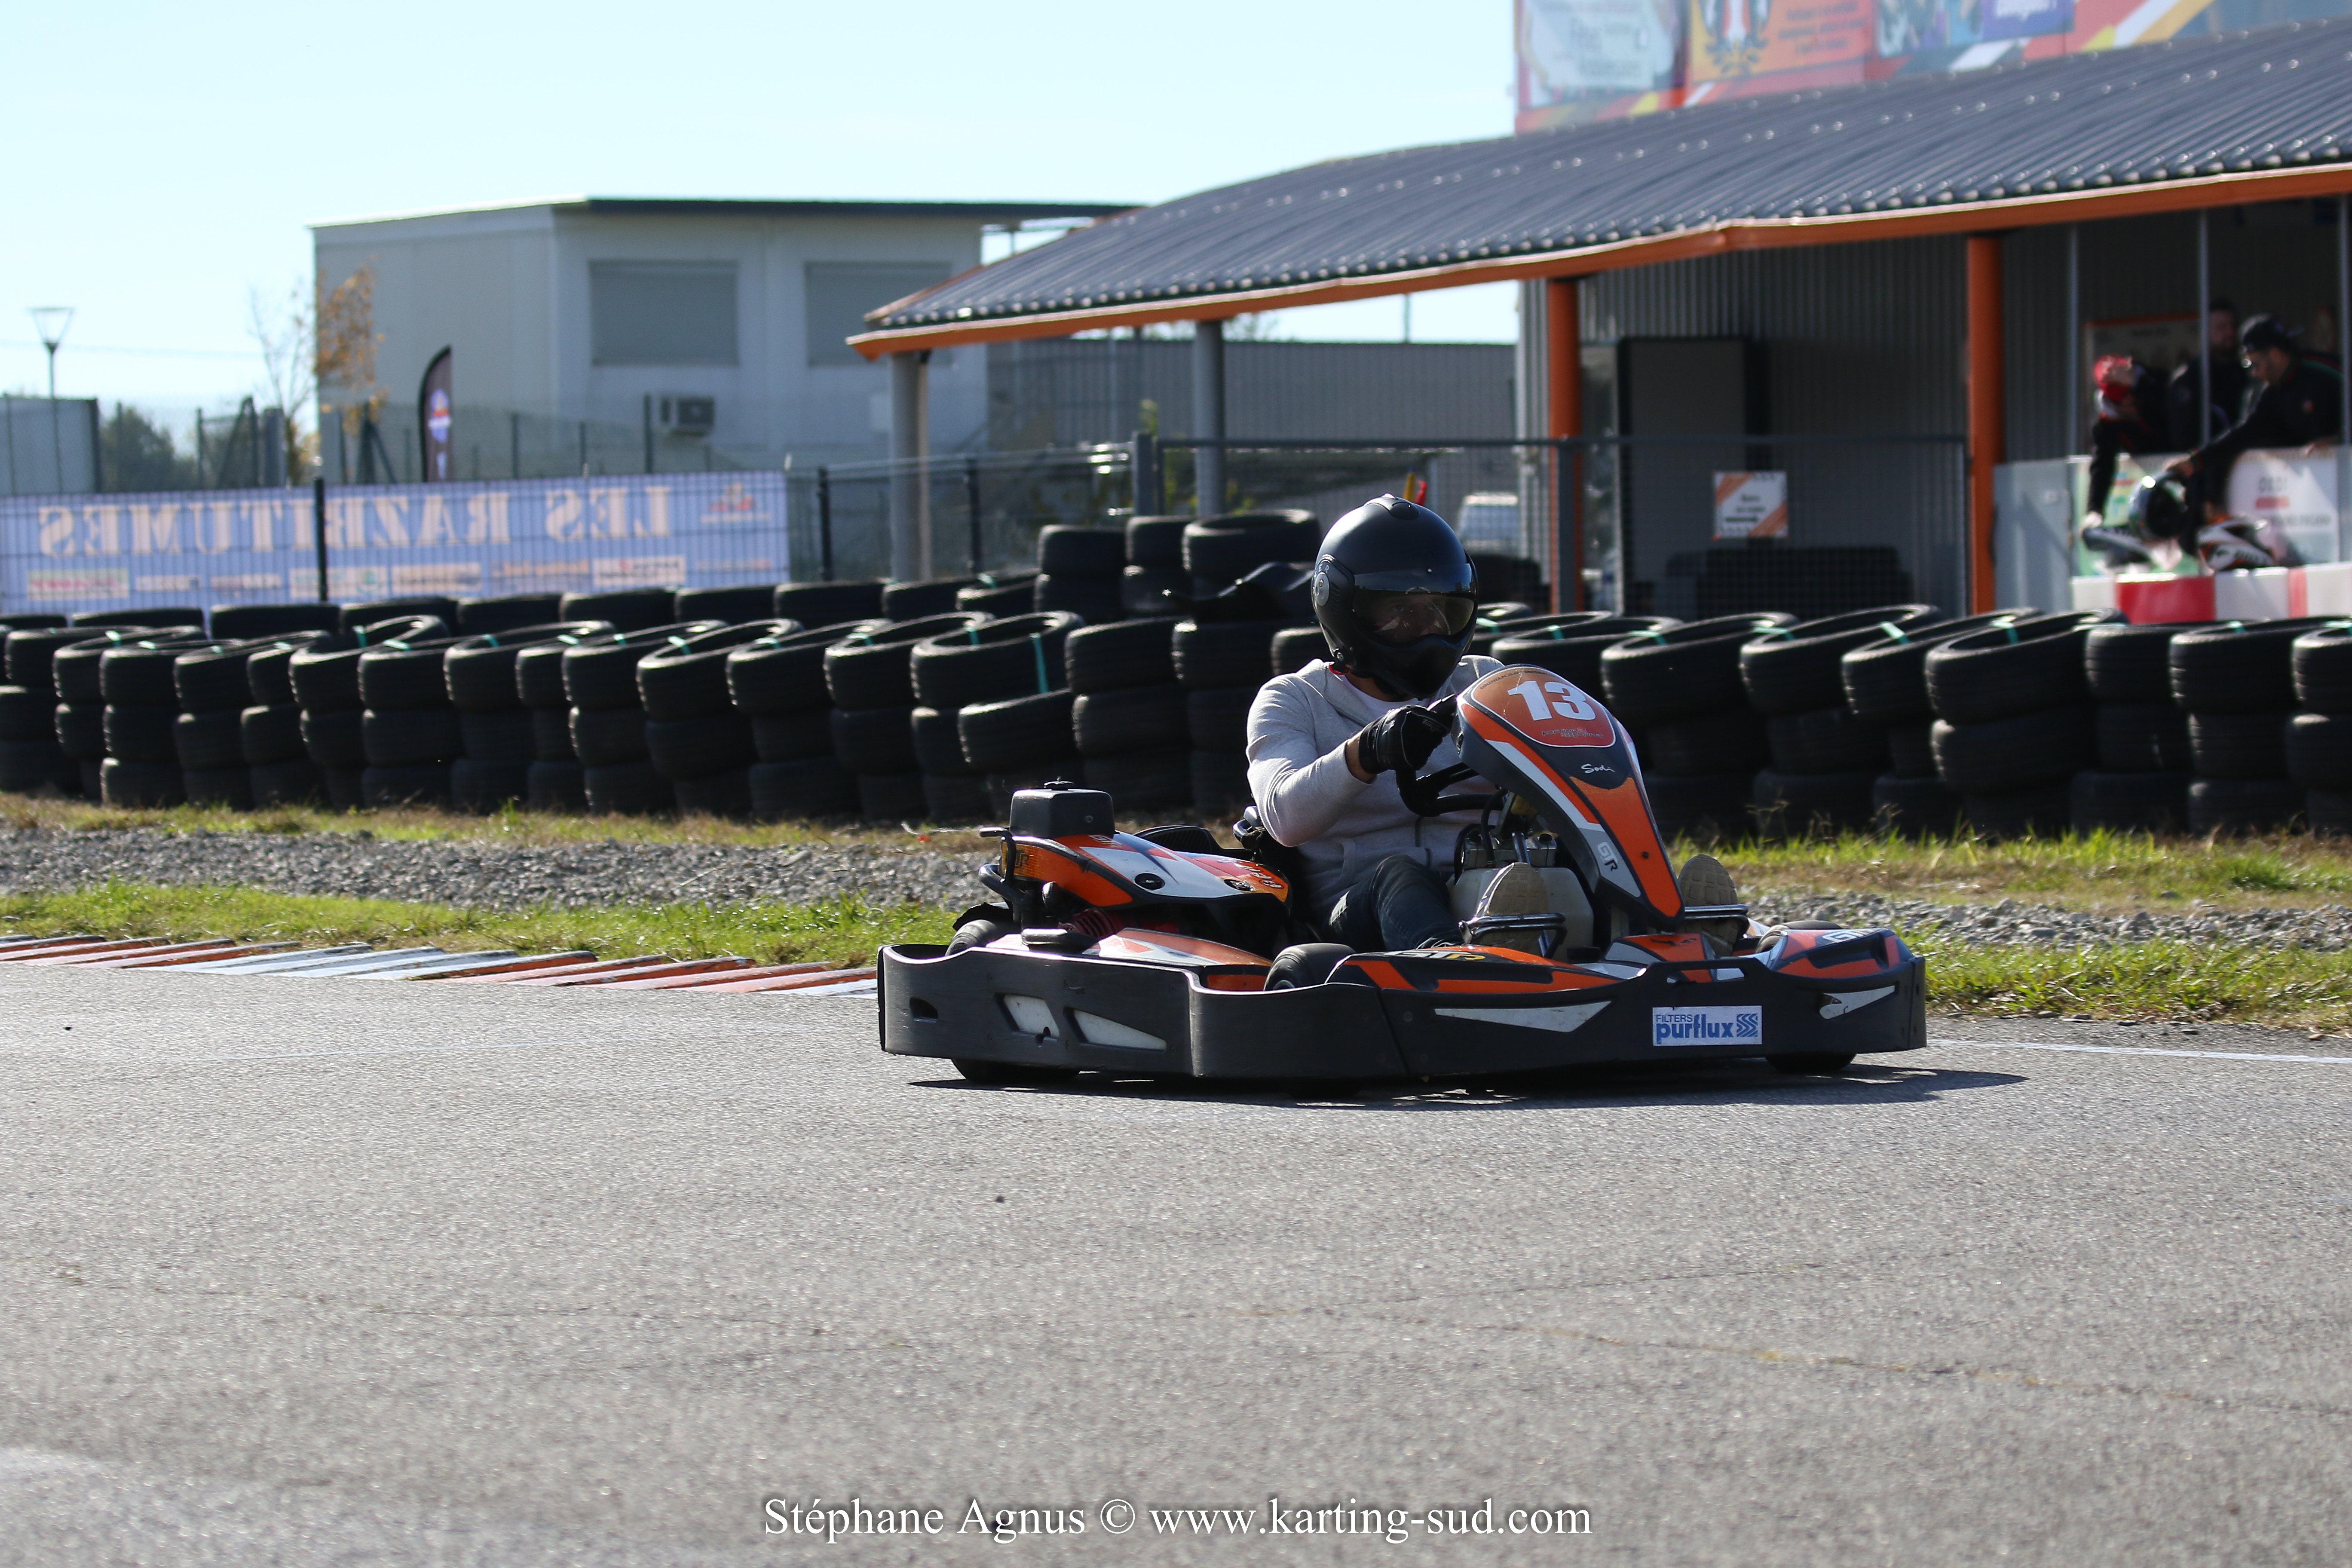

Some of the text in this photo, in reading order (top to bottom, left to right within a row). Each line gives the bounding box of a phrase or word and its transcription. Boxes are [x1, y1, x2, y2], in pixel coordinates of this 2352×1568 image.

[1507, 680, 1596, 721] 13
[1598, 841, 1618, 872] GTR
[1384, 949, 1486, 961] GTR
[1656, 1014, 1693, 1023] FILTERS
[1656, 1014, 1734, 1045] purflux
